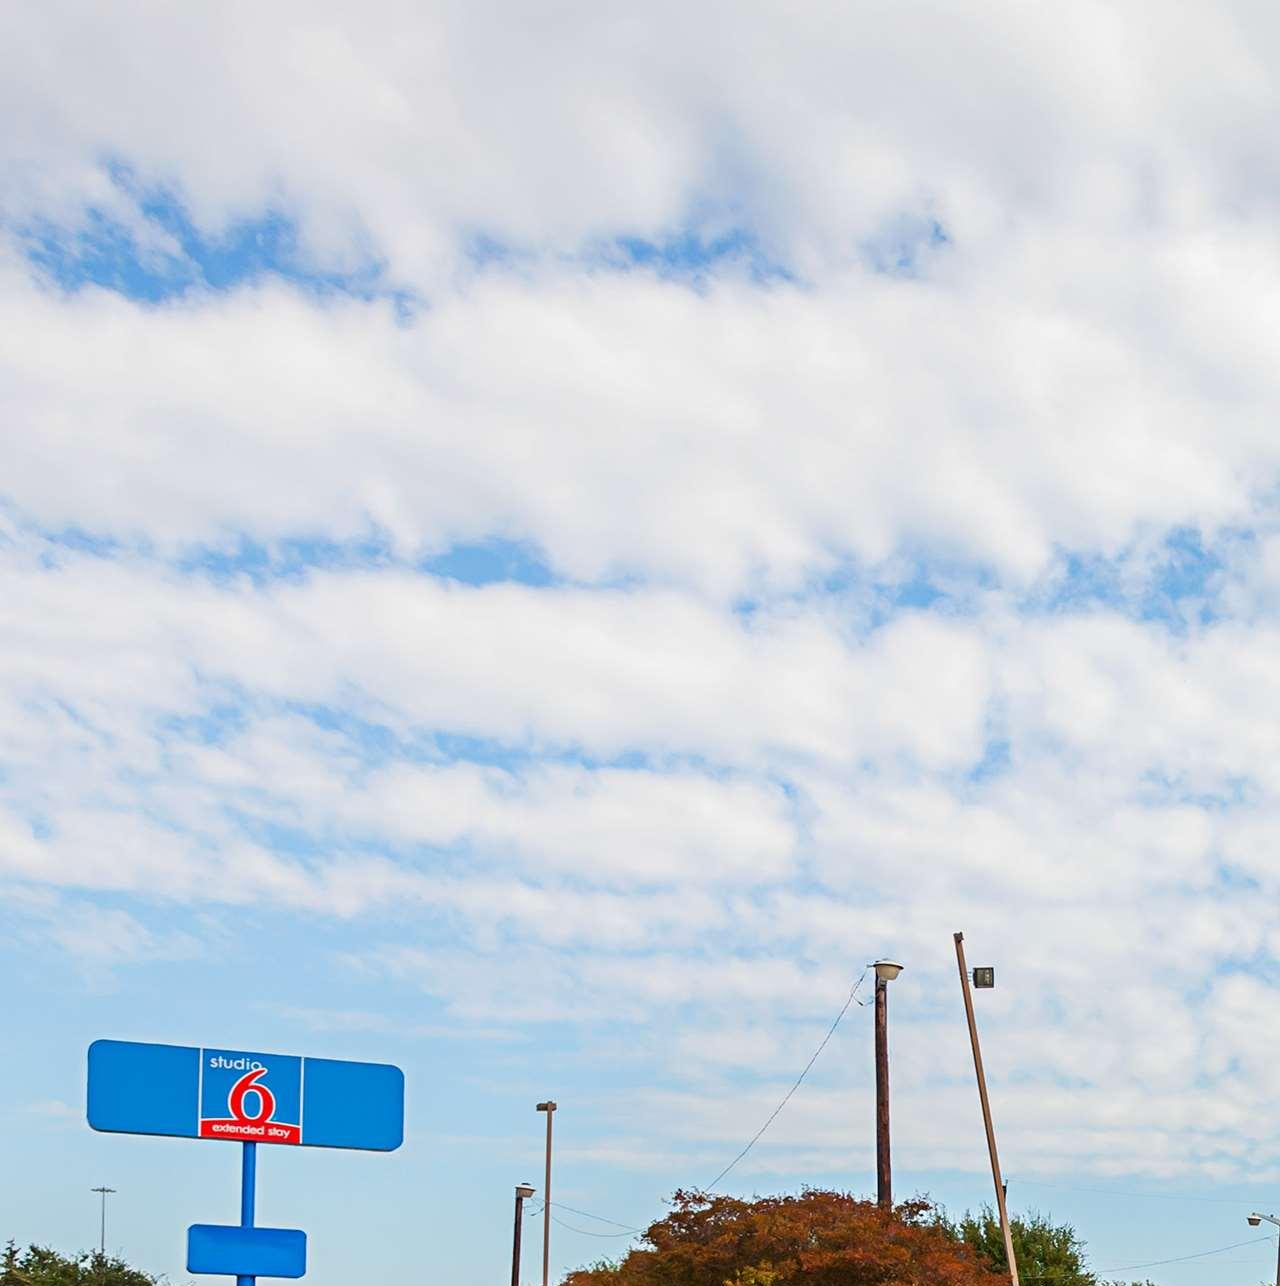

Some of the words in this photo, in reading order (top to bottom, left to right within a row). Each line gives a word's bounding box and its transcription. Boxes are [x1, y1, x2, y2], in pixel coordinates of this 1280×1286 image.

[210, 1055, 262, 1070] studio
[227, 1067, 276, 1121] 6
[212, 1123, 265, 1135] extended
[268, 1127, 290, 1139] stay
